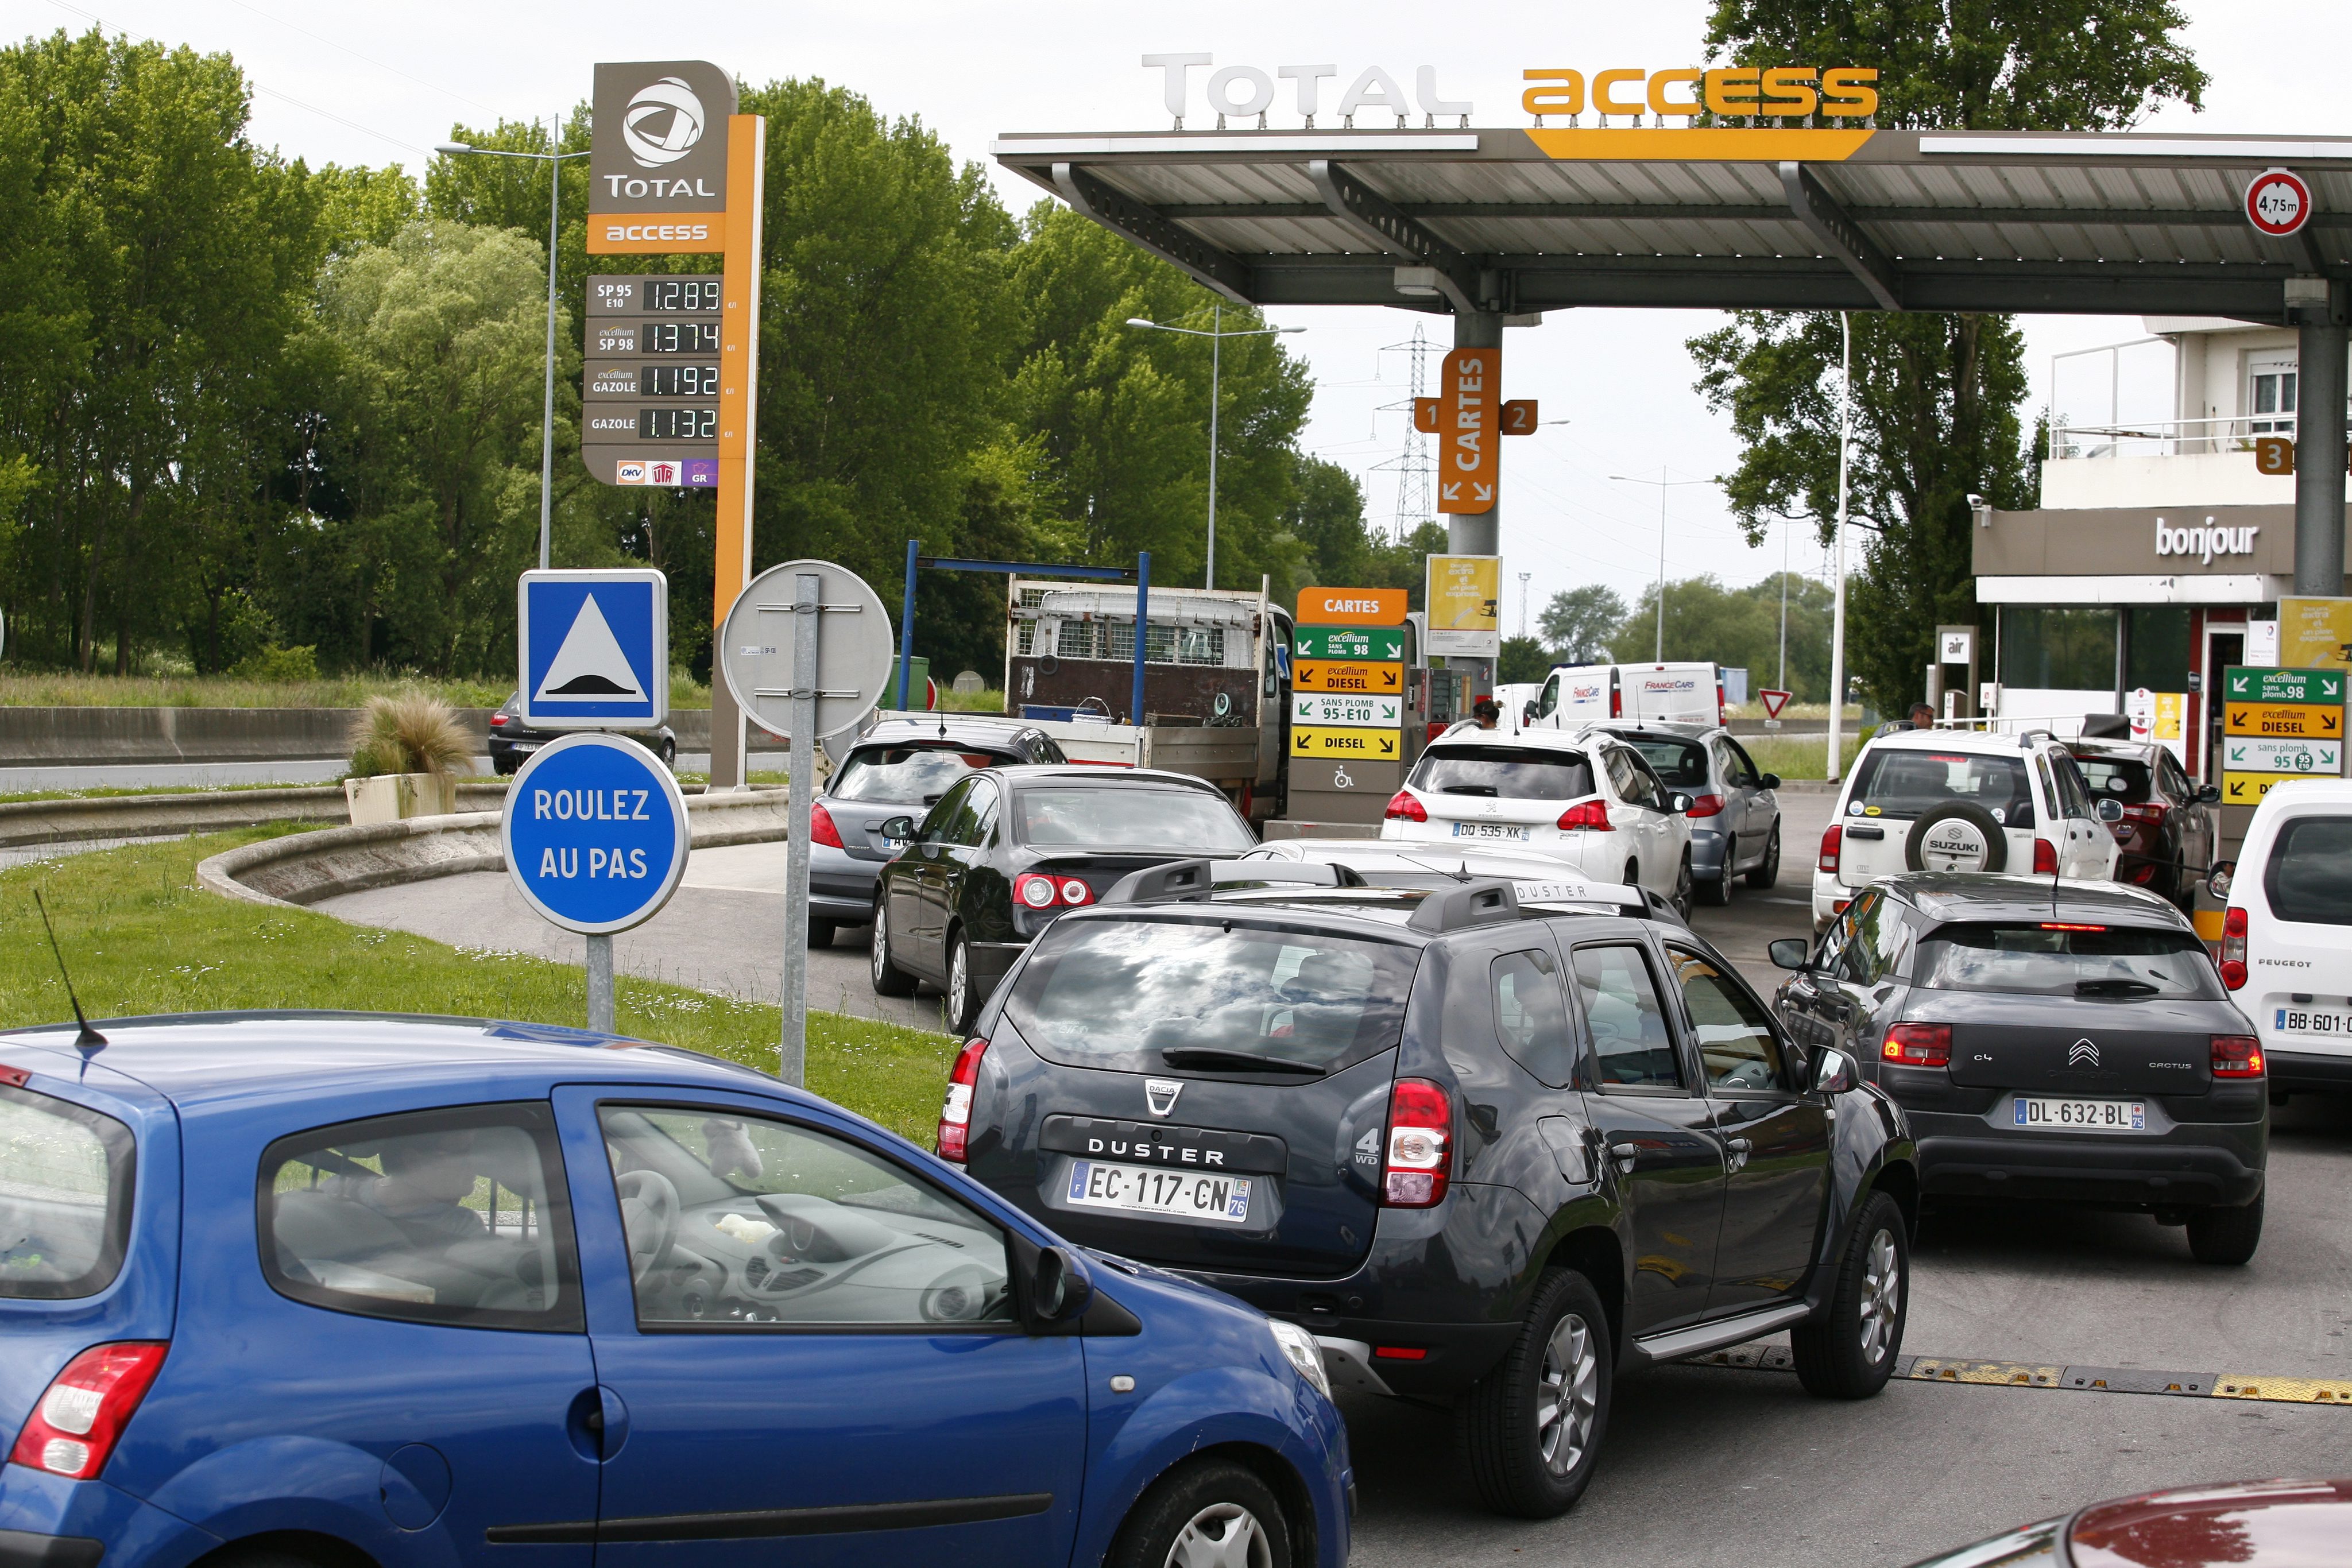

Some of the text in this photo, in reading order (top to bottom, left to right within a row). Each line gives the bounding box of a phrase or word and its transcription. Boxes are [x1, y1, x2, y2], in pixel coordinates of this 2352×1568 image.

[1142, 53, 1473, 117] TOTAL
[604, 175, 715, 198] TOTAL
[598, 285, 632, 297] SP 95
[655, 282, 719, 309] 1.289
[606, 299, 623, 308] E10
[599, 327, 634, 336] excellium
[655, 324, 718, 351] 1.374
[599, 338, 633, 351] SP 98
[598, 370, 633, 380] excellium
[654, 367, 718, 394] 1.192
[593, 382, 636, 392] GAZOLE
[1428, 405, 1436, 425] 1
[1456, 358, 1483, 471] CARTES
[1512, 407, 1526, 428] 2
[591, 419, 635, 429] GAZOLE
[652, 410, 715, 438] 1.132
[2266, 444, 2282, 469] 3
[621, 469, 642, 477] DKV
[653, 464, 672, 483] UTA
[692, 474, 707, 482] GR
[2156, 516, 2260, 565] bonjour
[1324, 599, 1379, 613] CARTES
[1328, 633, 1369, 643] excellium
[1353, 644, 1368, 655] 98
[1948, 637, 1963, 654] air
[1328, 665, 1368, 676] excellium
[1327, 678, 1367, 689] DIESEL
[2263, 674, 2306, 684] excellium
[2287, 686, 2304, 699] 98
[1321, 698, 1374, 707] SANS PLOMB
[1323, 708, 1370, 721] 95-E10
[2262, 709, 2305, 719] excellium
[2261, 722, 2305, 733] DIESEL
[1325, 737, 1365, 749] DIESEL
[2280, 744, 2308, 753] plomb
[2274, 754, 2310, 768] 95 95
[535, 789, 649, 820] ROULEZ
[1930, 841, 1979, 852] SUZUKI
[540, 848, 647, 878] AU PAS
[1517, 886, 1587, 899] DUSTER
[2258, 959, 2312, 967] PEUGEOT
[2029, 1102, 2128, 1125] DL-632-BL
[2133, 1117, 2142, 1127] 75
[1356, 1128, 1379, 1153] 4
[1089, 1139, 1224, 1165] DUSTER
[1356, 1155, 1378, 1165] WD
[1075, 1167, 1245, 1214] F EC-117-CN 76
[1120, 1204, 1187, 1214] www.toprenault.com
